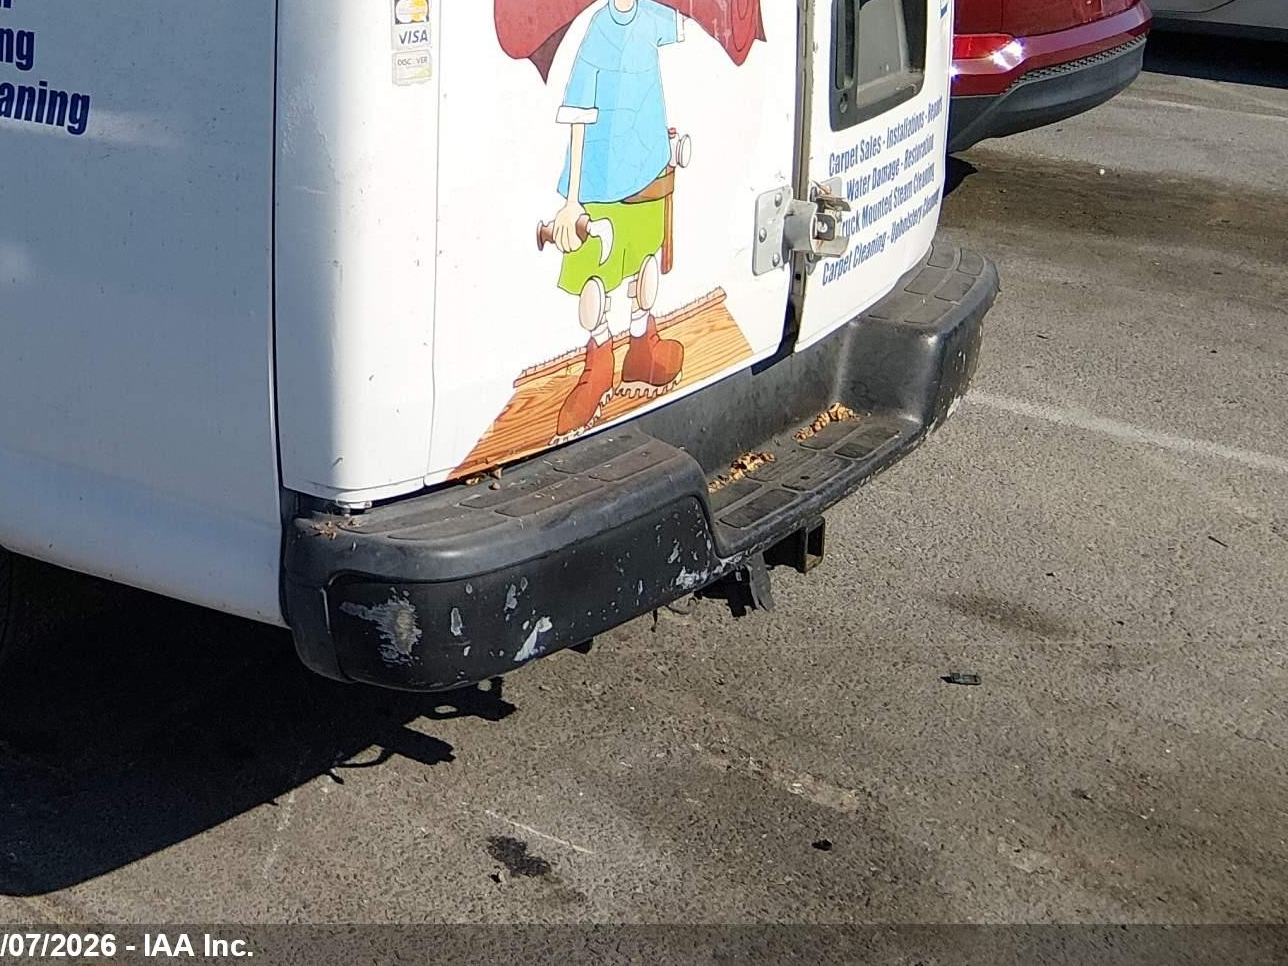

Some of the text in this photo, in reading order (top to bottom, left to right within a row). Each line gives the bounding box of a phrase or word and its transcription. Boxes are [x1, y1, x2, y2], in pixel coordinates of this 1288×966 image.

[399, 29, 428, 45] VISA
[397, 56, 428, 66] DISCVER
[829, 143, 859, 177] Carpet
[860, 135, 882, 163] Sales
[846, 174, 871, 202] Water
[872, 157, 901, 191] Damage
[841, 210, 860, 238] ruck
[861, 190, 892, 230] Mounted
[893, 180, 913, 208] Steam
[822, 250, 853, 287] Carpet
[853, 232, 887, 268] Cleaning
